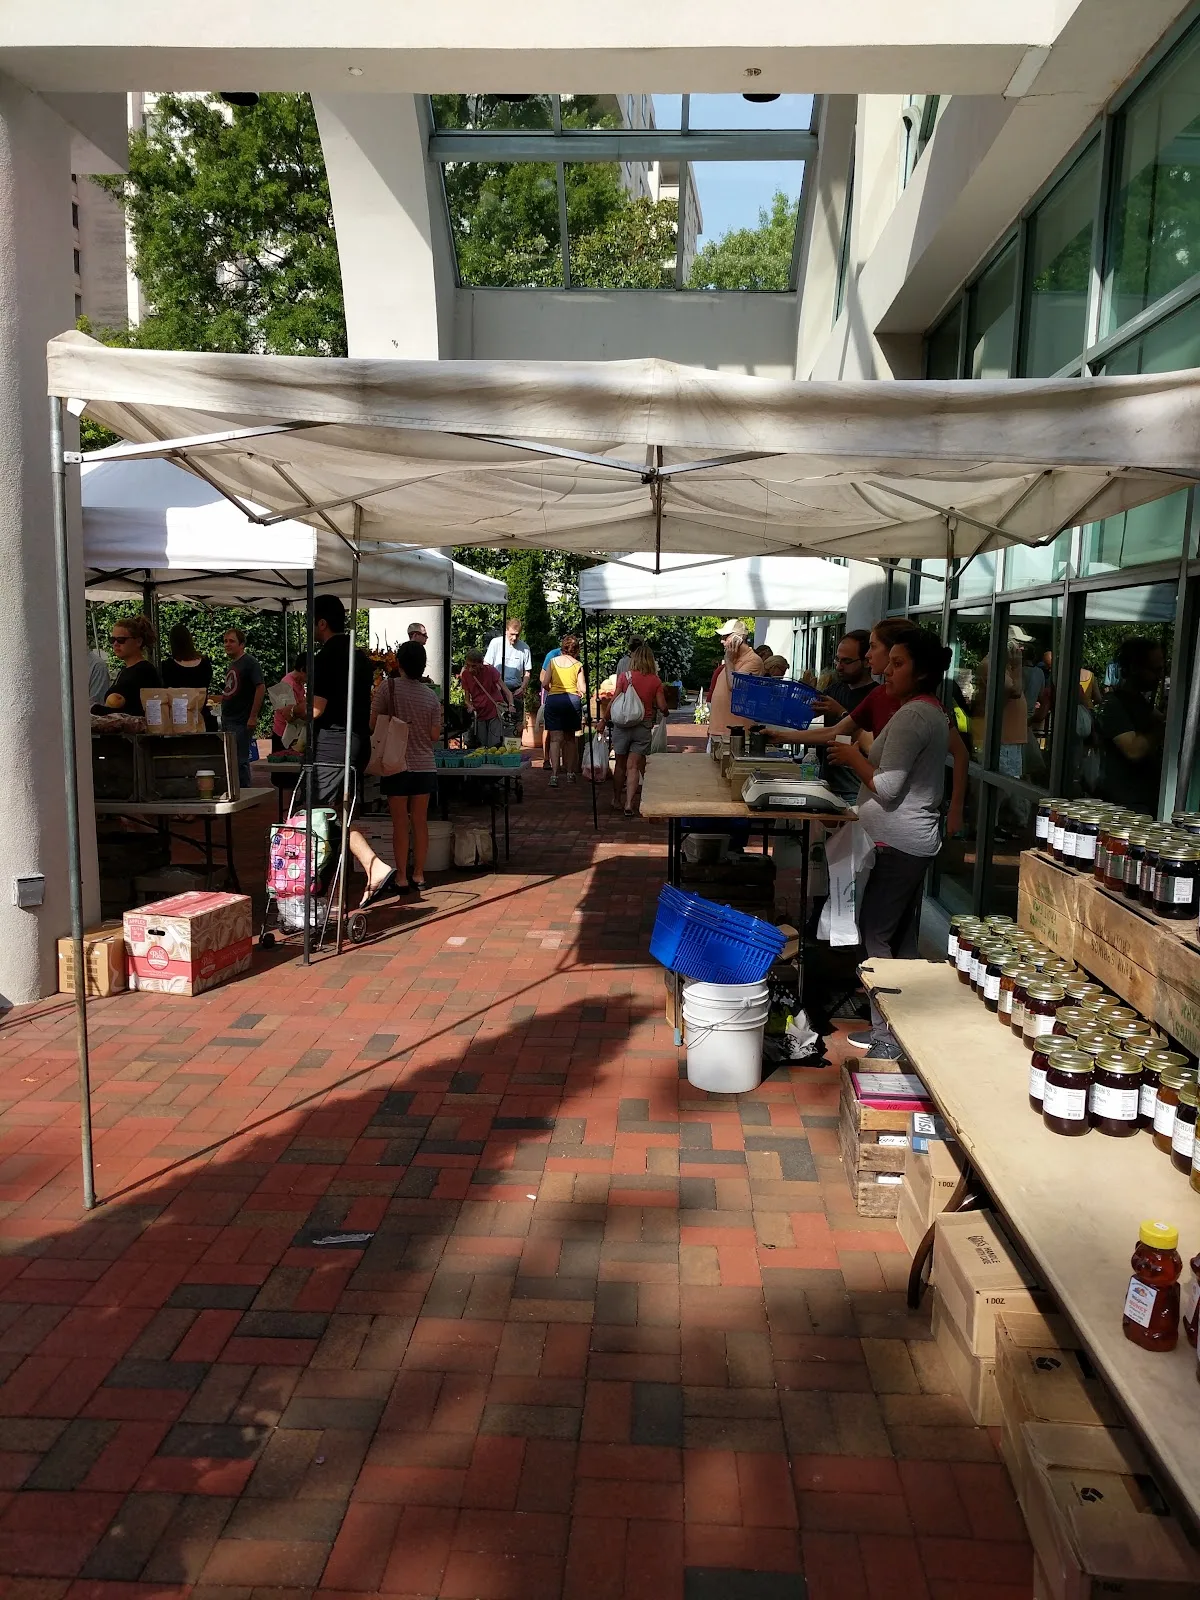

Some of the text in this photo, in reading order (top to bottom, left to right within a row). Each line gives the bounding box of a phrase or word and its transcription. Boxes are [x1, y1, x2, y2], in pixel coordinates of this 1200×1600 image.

[128, 918, 146, 926] APPLES
[918, 1115, 933, 1133] VISA
[1128, 1300, 1148, 1313] HONEY
